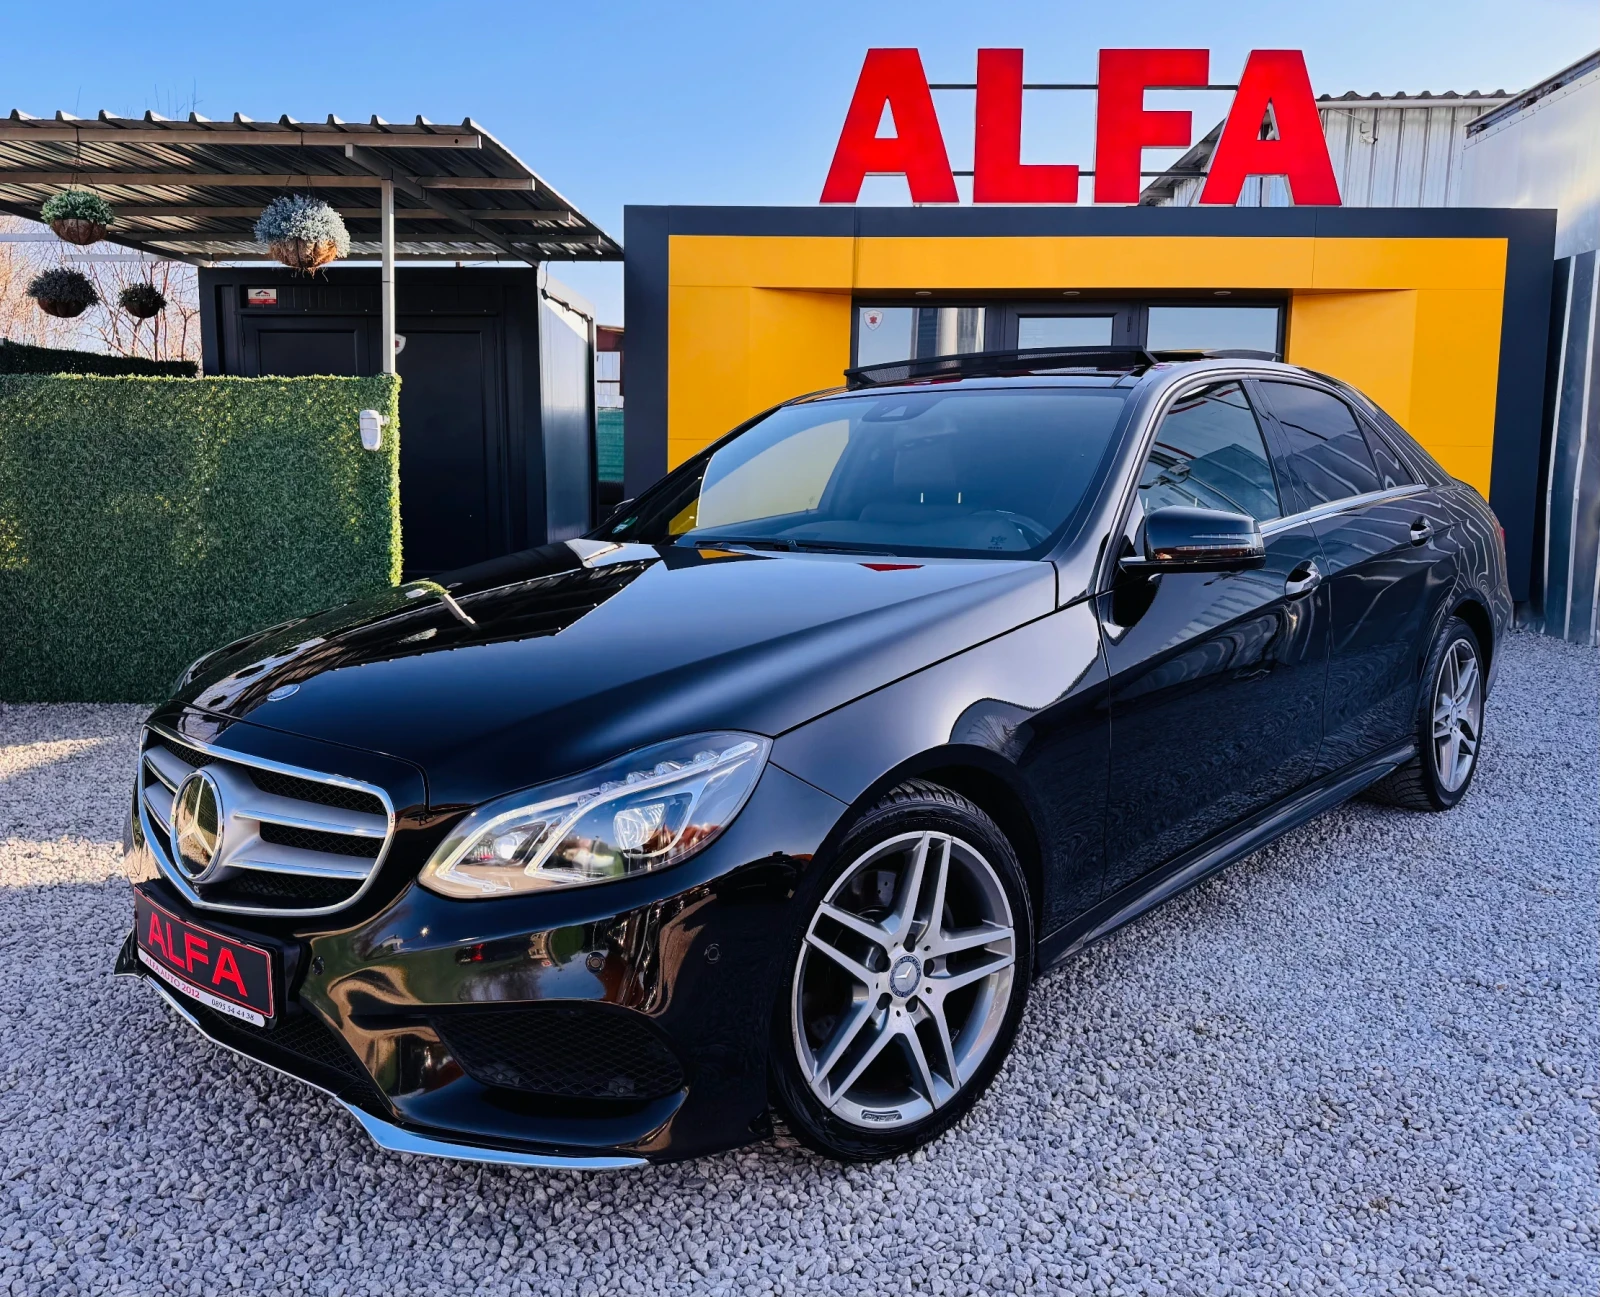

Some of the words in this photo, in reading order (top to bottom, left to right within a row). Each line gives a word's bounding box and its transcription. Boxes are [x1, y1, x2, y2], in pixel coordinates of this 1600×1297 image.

[819, 48, 1342, 205] ALFA
[146, 957, 160, 972] ALFA
[160, 967, 181, 987] AUTO
[182, 982, 200, 998] 2012
[148, 912, 248, 997] ALFA
[211, 999, 226, 1011] 0895
[227, 1004, 235, 1014] 54
[236, 1008, 245, 1018] 44
[246, 1011, 255, 1021] 38
